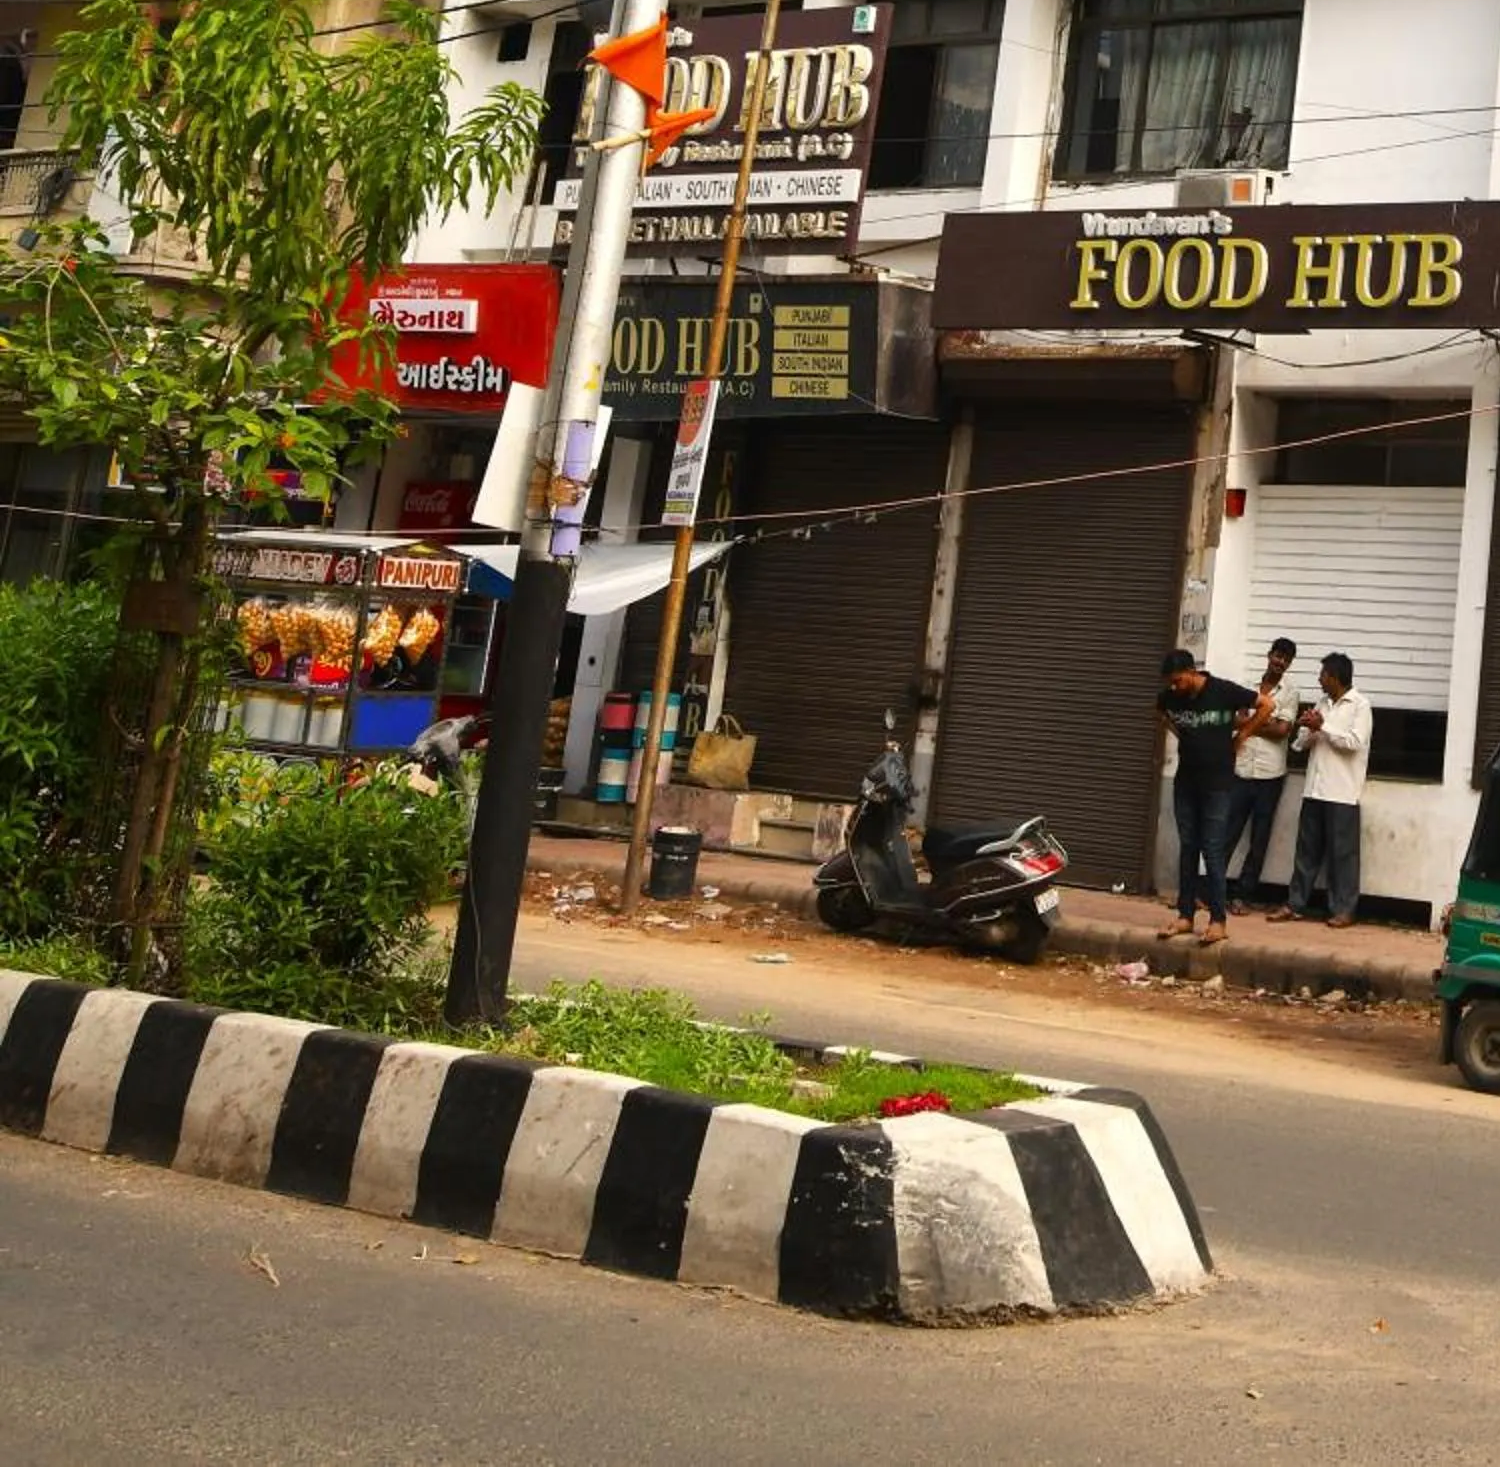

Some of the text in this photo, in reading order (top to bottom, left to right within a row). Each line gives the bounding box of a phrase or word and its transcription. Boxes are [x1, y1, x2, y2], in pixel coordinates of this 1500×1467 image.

[733, 44, 873, 131] HUB
[634, 180, 673, 201] ALIAN
[685, 179, 728, 201] SOUTH
[786, 175, 844, 197] CHINESE
[719, 210, 849, 241] AAILABLE
[1081, 211, 1233, 237] Vrundavan's
[1069, 234, 1463, 309] FOOD HUB
[612, 316, 666, 375] OD
[792, 332, 829, 347] ITALIAN
[602, 378, 637, 395] amily
[641, 379, 687, 395] Restau
[383, 559, 459, 588] PANIPURI
